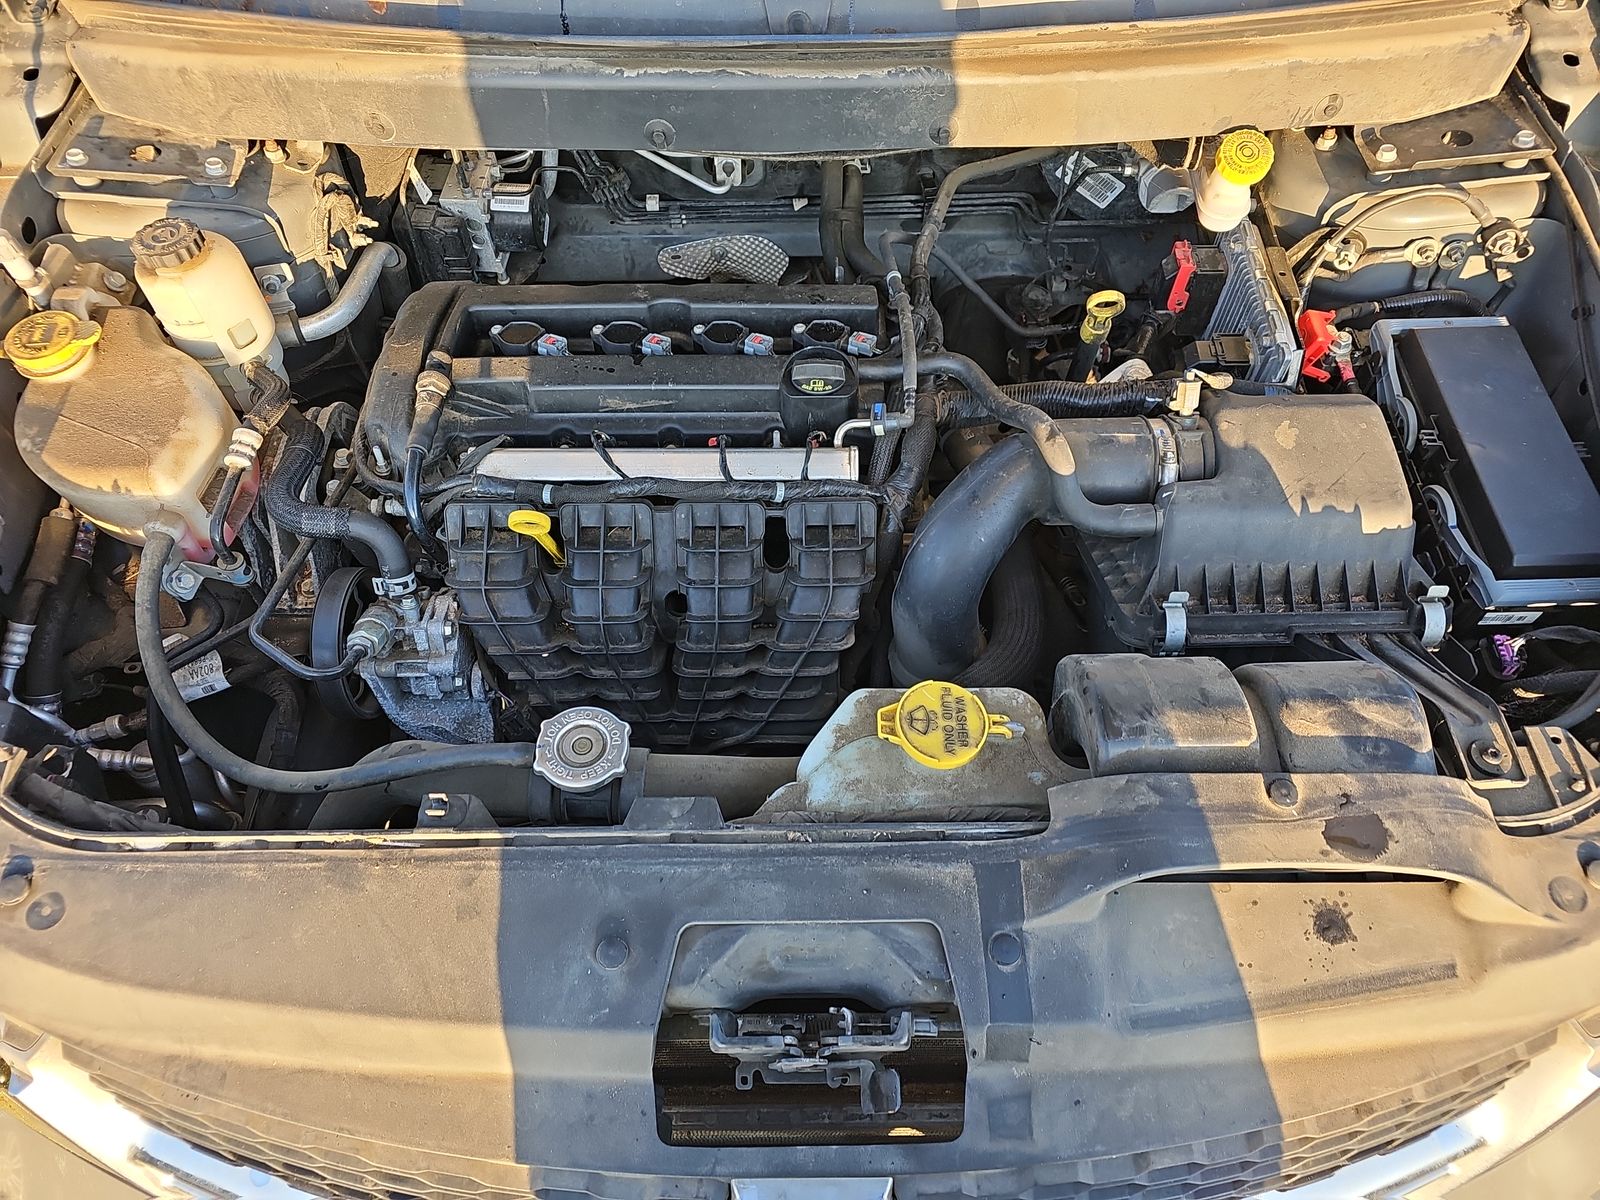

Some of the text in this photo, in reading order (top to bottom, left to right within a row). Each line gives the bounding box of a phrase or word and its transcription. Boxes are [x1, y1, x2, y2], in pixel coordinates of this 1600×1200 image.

[188, 662, 214, 680] 802AA
[543, 710, 622, 745] DO NOT OPEN HOT
[940, 686, 956, 756] FLUID ONLY
[955, 695, 969, 748] WASHER
[545, 759, 612, 780] KEEP TIGHT
